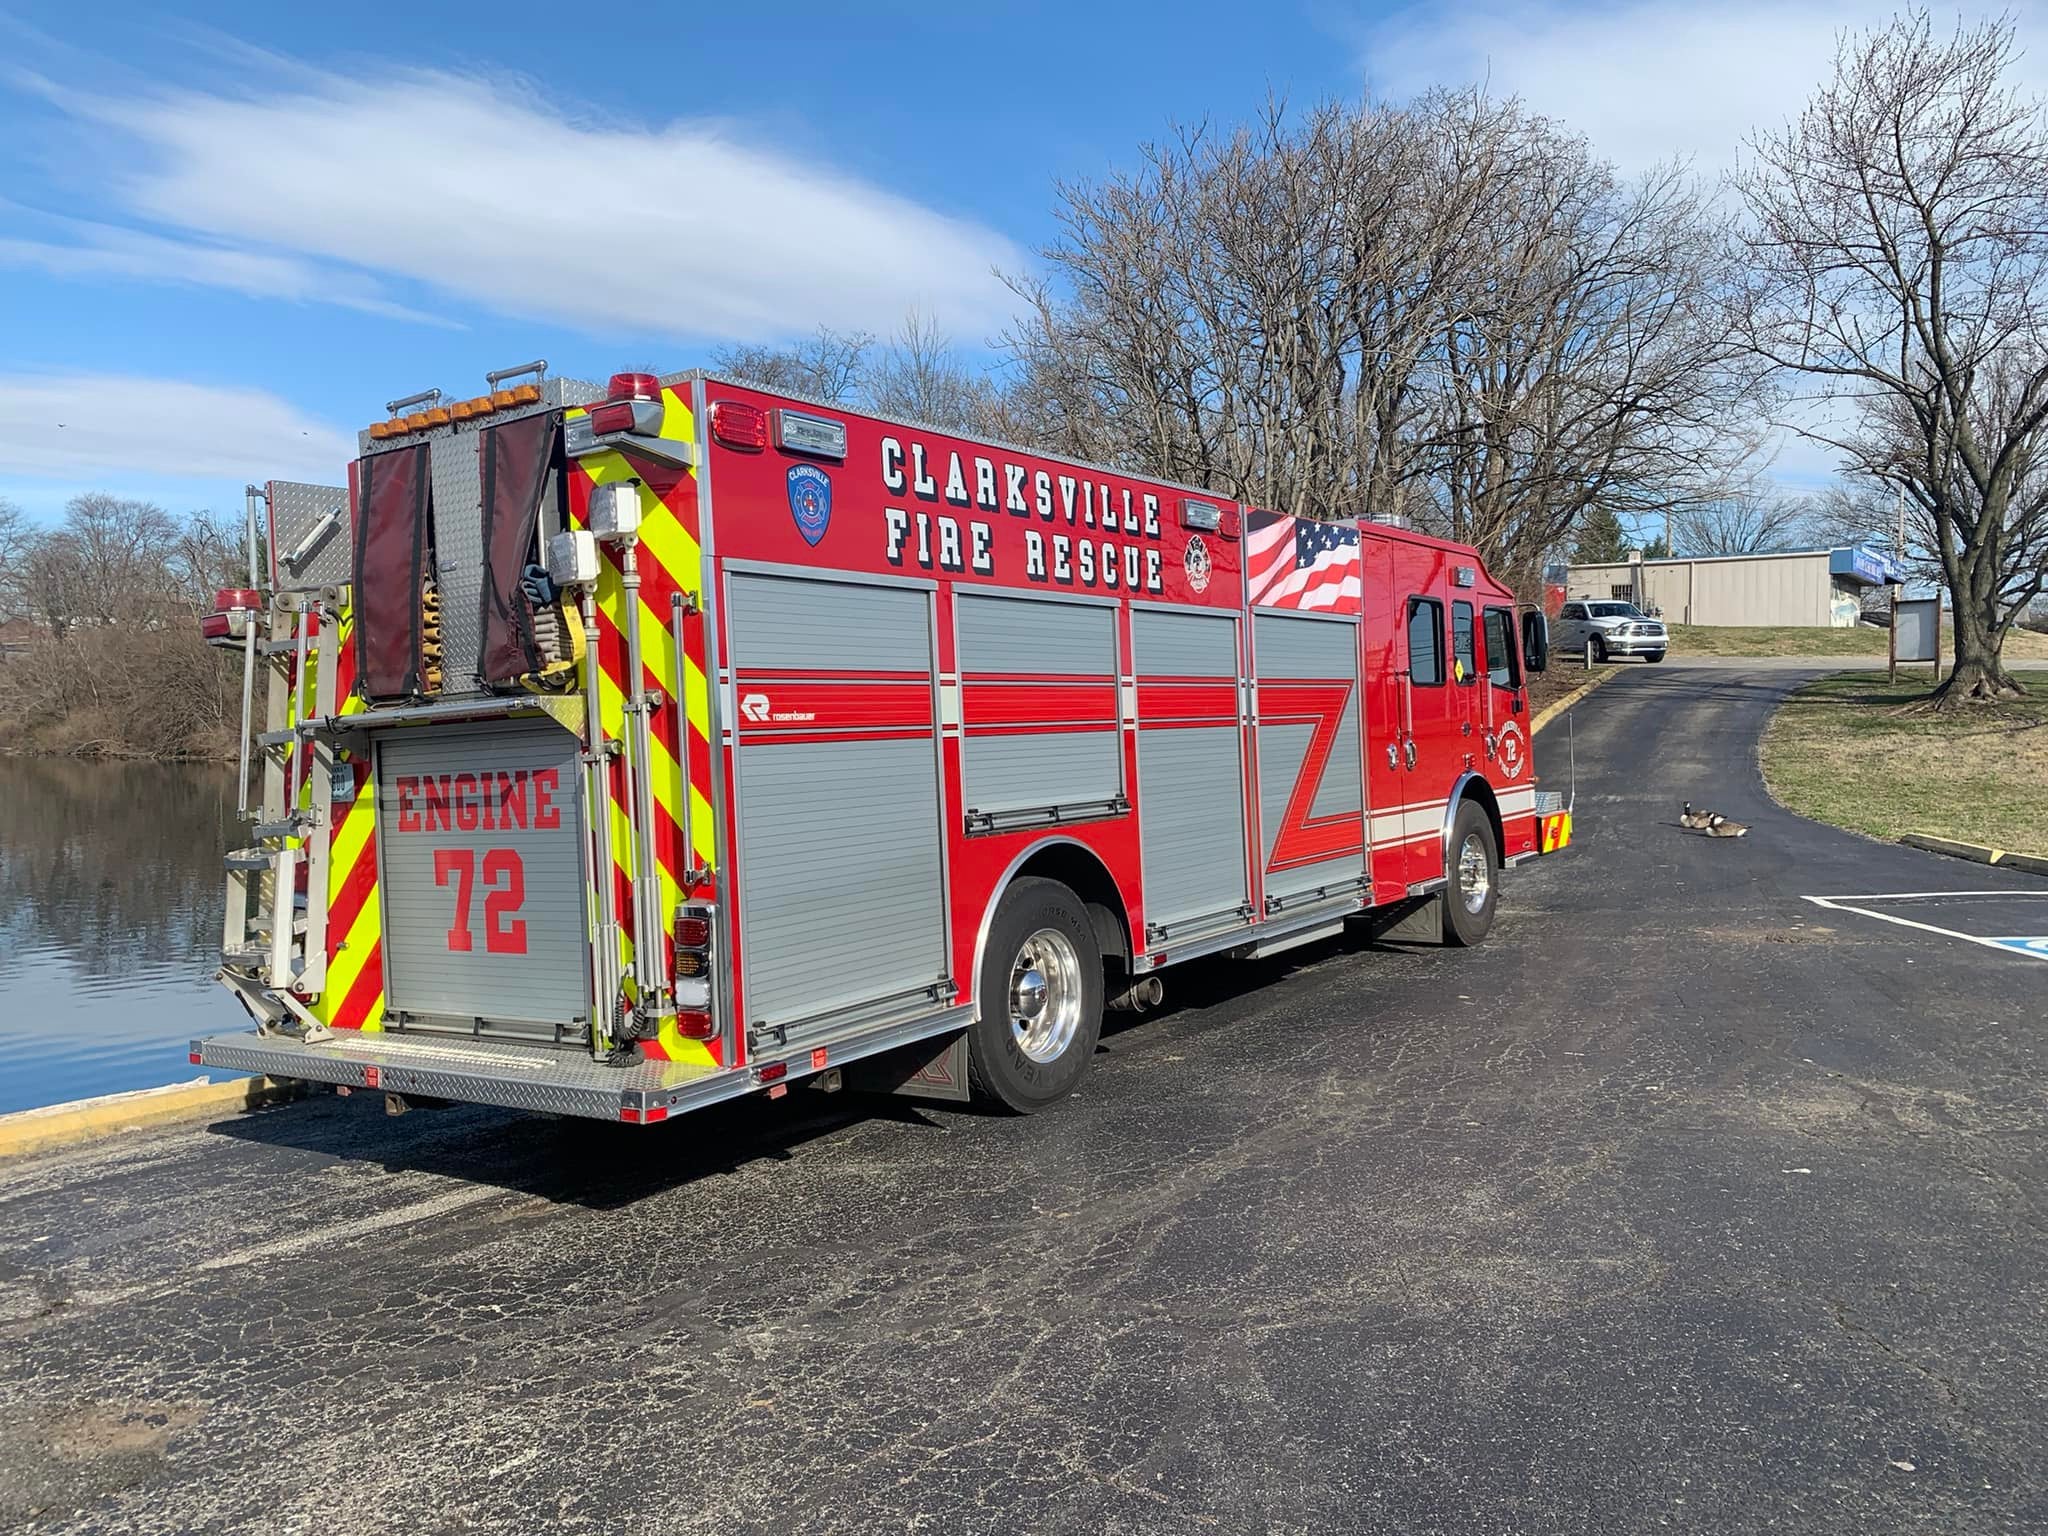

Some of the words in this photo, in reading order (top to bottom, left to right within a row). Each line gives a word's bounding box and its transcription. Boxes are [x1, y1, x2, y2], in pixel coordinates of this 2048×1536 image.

[788, 467, 830, 488] CLARKSVILLE
[881, 437, 1161, 537] CLARKSVILLE
[884, 507, 993, 574] FIRE
[1024, 530, 1163, 592] RESCUE
[1505, 739, 1517, 761] 72
[396, 768, 561, 832] ENGINE
[433, 848, 528, 954] 72
